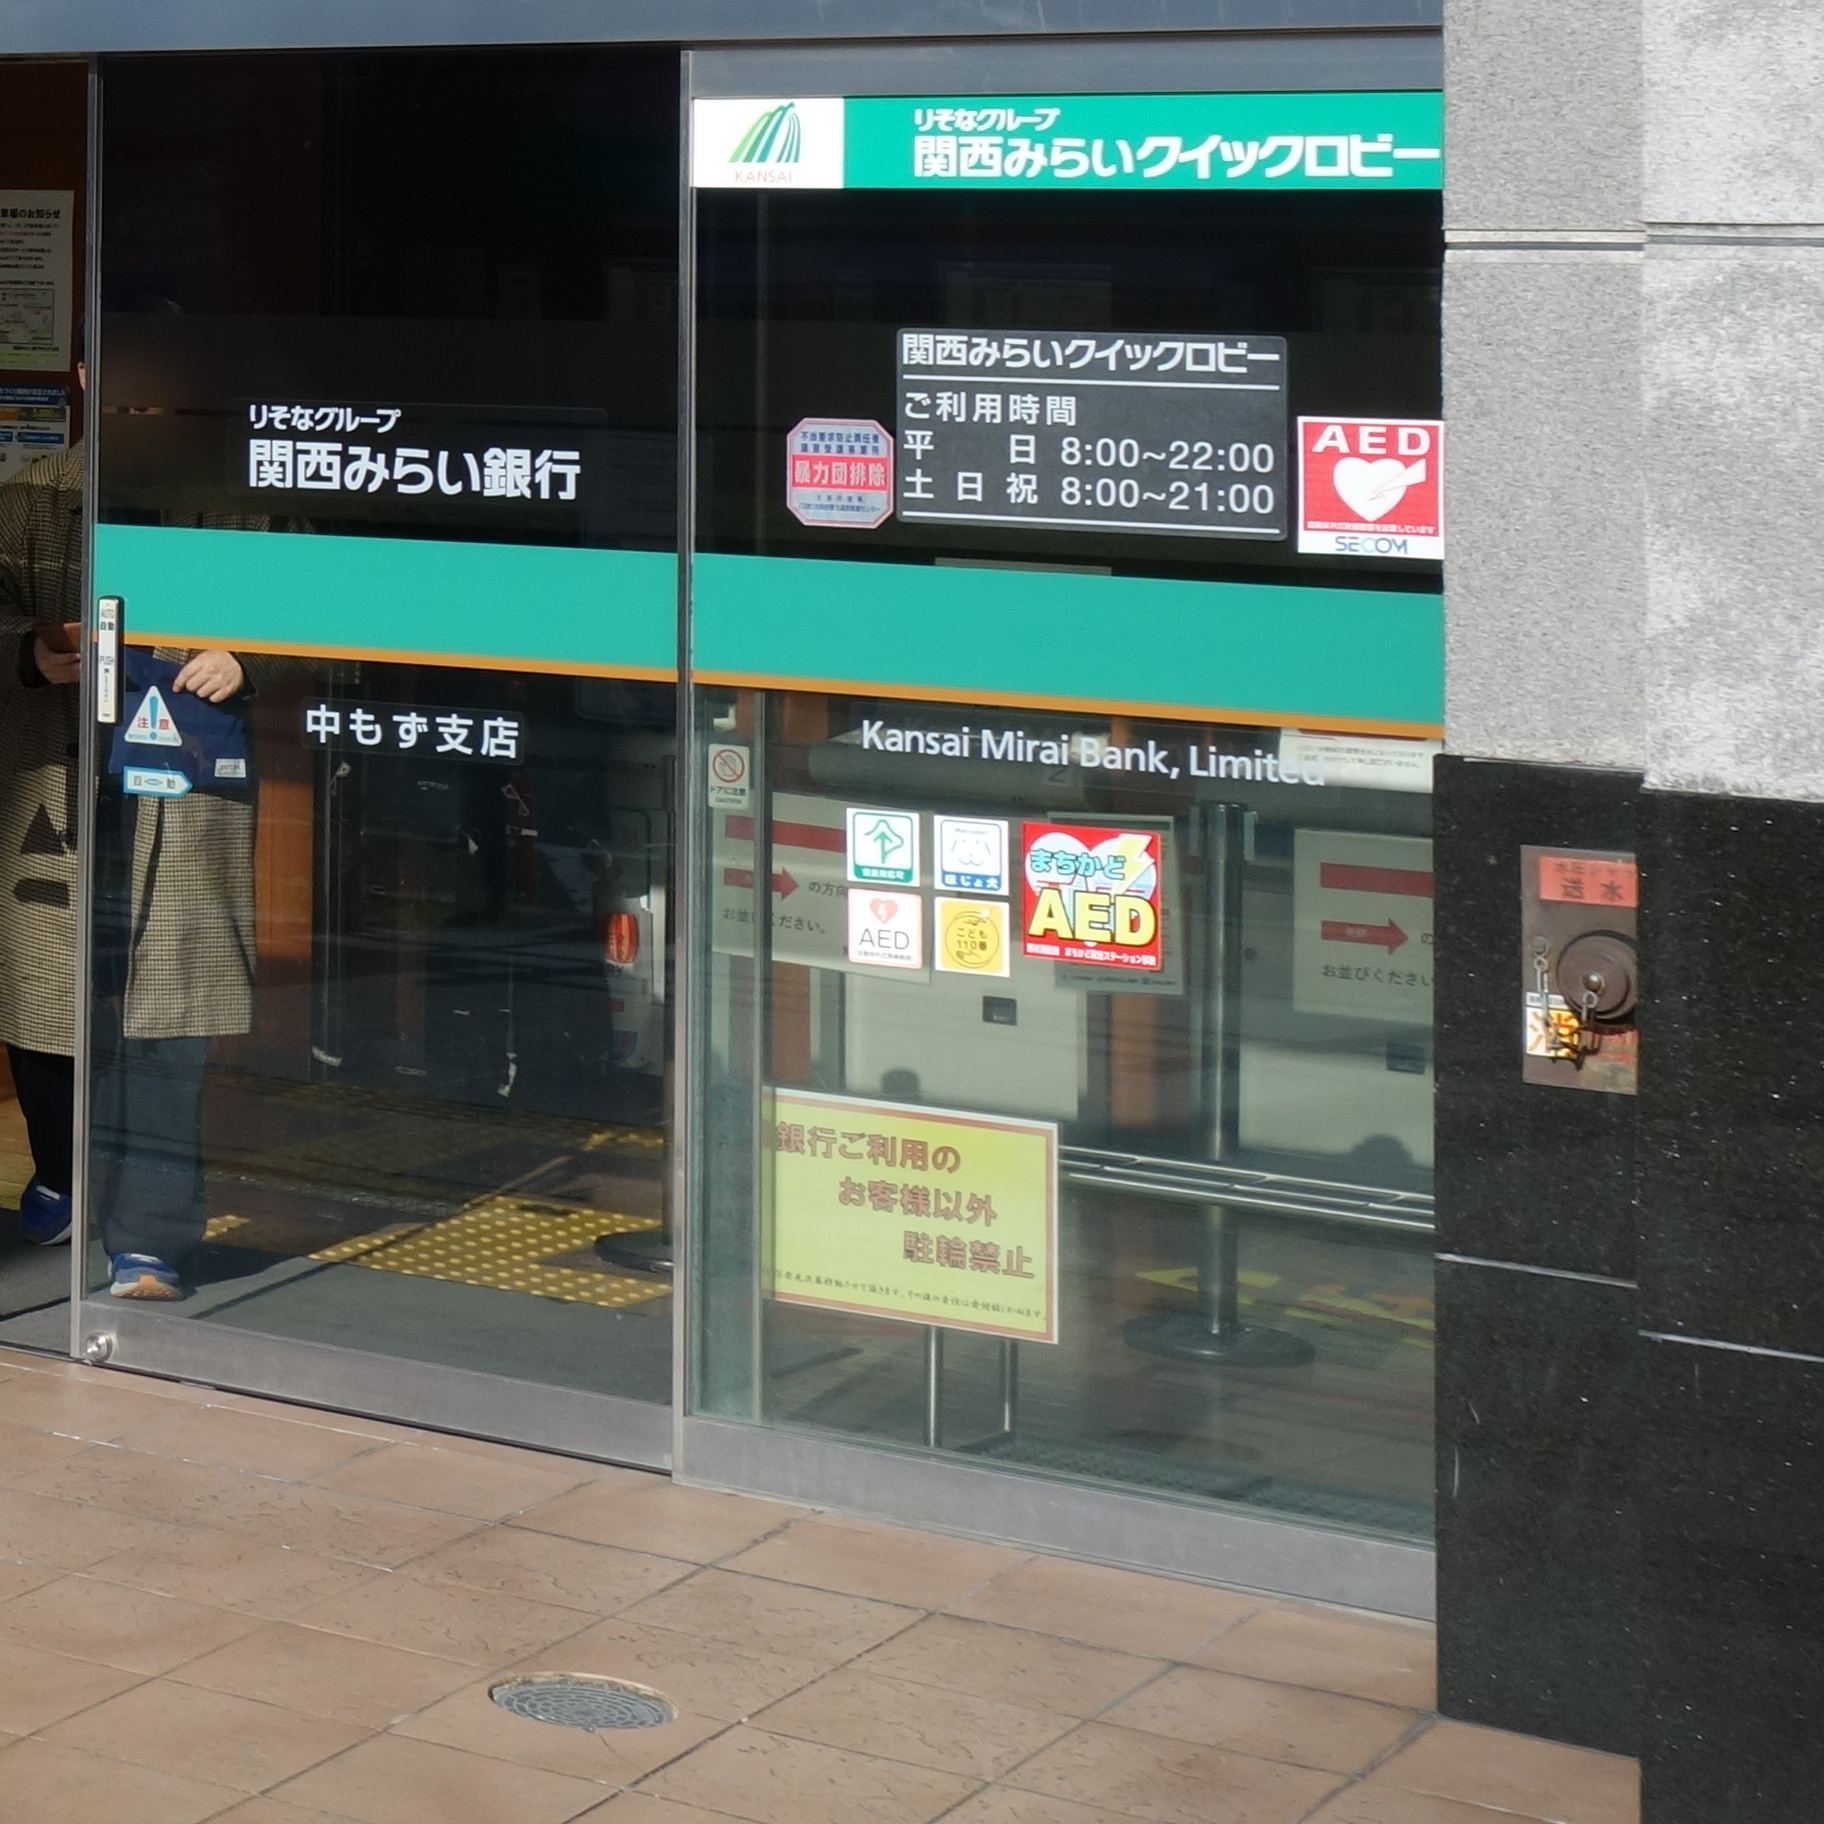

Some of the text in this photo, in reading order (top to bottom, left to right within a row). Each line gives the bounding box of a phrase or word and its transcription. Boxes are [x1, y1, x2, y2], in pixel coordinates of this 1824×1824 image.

[913, 107, 1060, 132] りそなグループ
[913, 134, 1442, 180] 関西みらいクイックロビー
[733, 169, 793, 184] KANSAI
[902, 333, 1281, 375] 関西みらいクイックロビー
[249, 404, 402, 433] りそなグループ
[904, 391, 1078, 427] ご利用時間
[1060, 435, 1275, 474] 8:00~22:00
[1311, 424, 1431, 456] AED
[249, 438, 581, 500] 関西みらい銀行
[794, 459, 886, 487] 暴力団排除
[1060, 476, 1275, 514] 8:00~21:00
[1334, 535, 1408, 555] SECOM
[136, 717, 170, 731] 注意
[306, 703, 520, 759] 中もず支店
[861, 718, 1327, 787] Kansai Mirai Bank, Limited
[133, 775, 176, 790] 自動
[1029, 847, 1128, 881] まちかど
[1027, 886, 1159, 948] AED
[858, 926, 911, 951] AED
[775, 1121, 962, 1174] 銀行ご利用の
[838, 1176, 999, 1227] お客様以外
[902, 1230, 1036, 1280] 駐輪禁止
